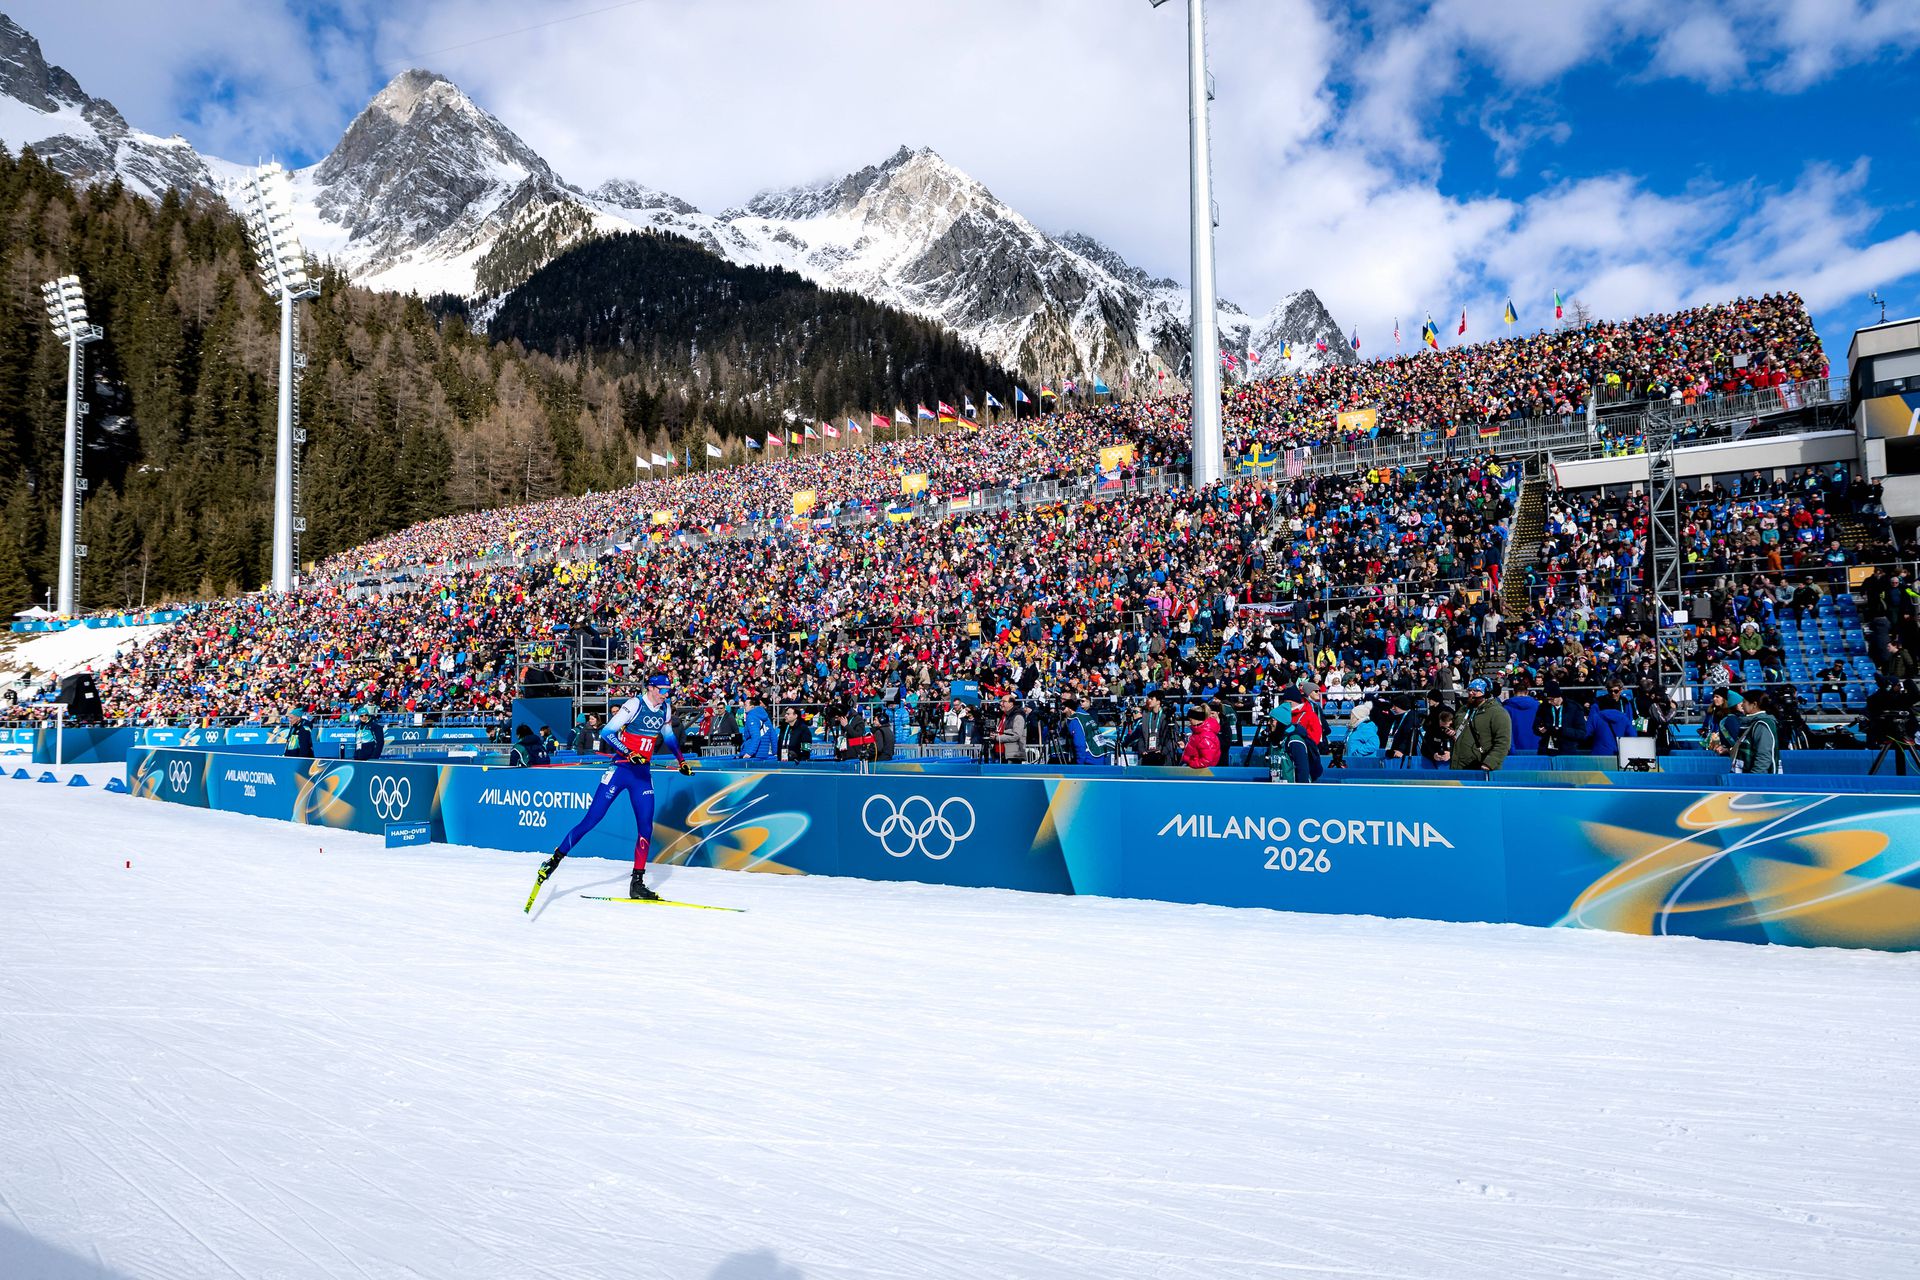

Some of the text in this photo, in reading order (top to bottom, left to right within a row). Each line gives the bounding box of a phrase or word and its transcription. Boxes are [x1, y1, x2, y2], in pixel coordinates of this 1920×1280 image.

[224, 769, 276, 785] MILANO CORTINA
[244, 784, 256, 797] 2026
[478, 788, 531, 807] MILANO
[518, 809, 547, 827] 2026
[390, 827, 426, 837] HAND-OVER
[1157, 813, 1455, 849] MILANO CORTINA
[1263, 846, 1331, 873] 2026
